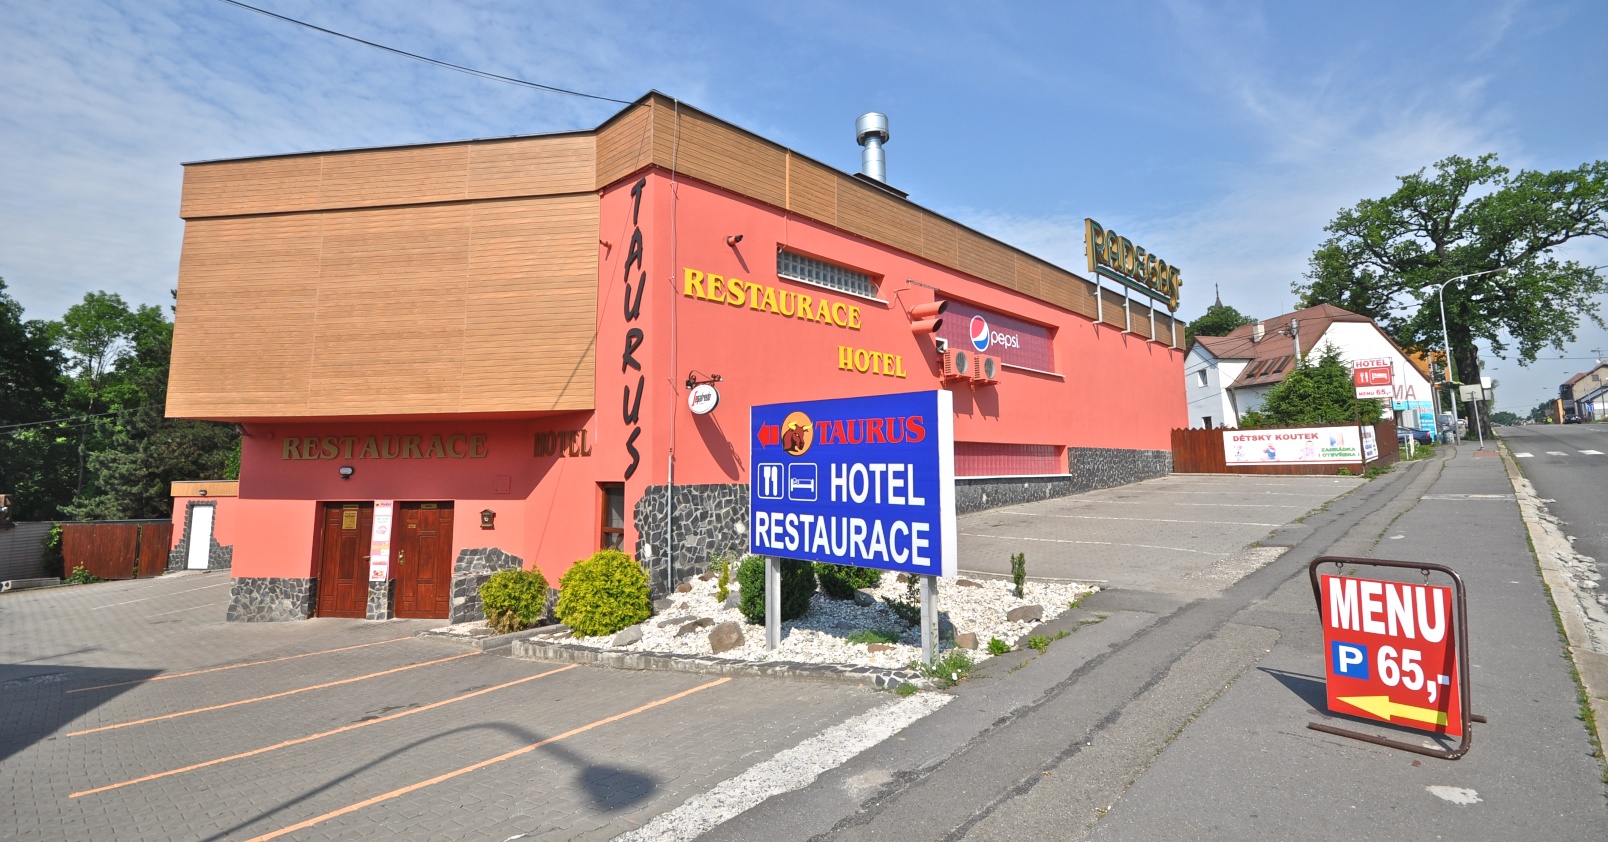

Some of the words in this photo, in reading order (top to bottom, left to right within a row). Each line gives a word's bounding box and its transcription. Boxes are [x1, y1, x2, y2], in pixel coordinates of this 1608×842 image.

[683, 267, 862, 330] RESTAURACE
[621, 177, 646, 480] TAURUS
[990, 331, 1019, 349] pepsi
[838, 345, 907, 378] HOTEL
[1356, 359, 1388, 368] HOTEL
[533, 428, 593, 458] HOTEL
[815, 415, 926, 445] TAURUS
[1275, 432, 1319, 441] KOUTEK
[281, 433, 488, 461] RESTAURACE
[830, 463, 926, 506] HOTEL
[755, 511, 931, 567] RESTAURACE
[1329, 577, 1446, 643] MENU
[1338, 645, 1364, 673] P
